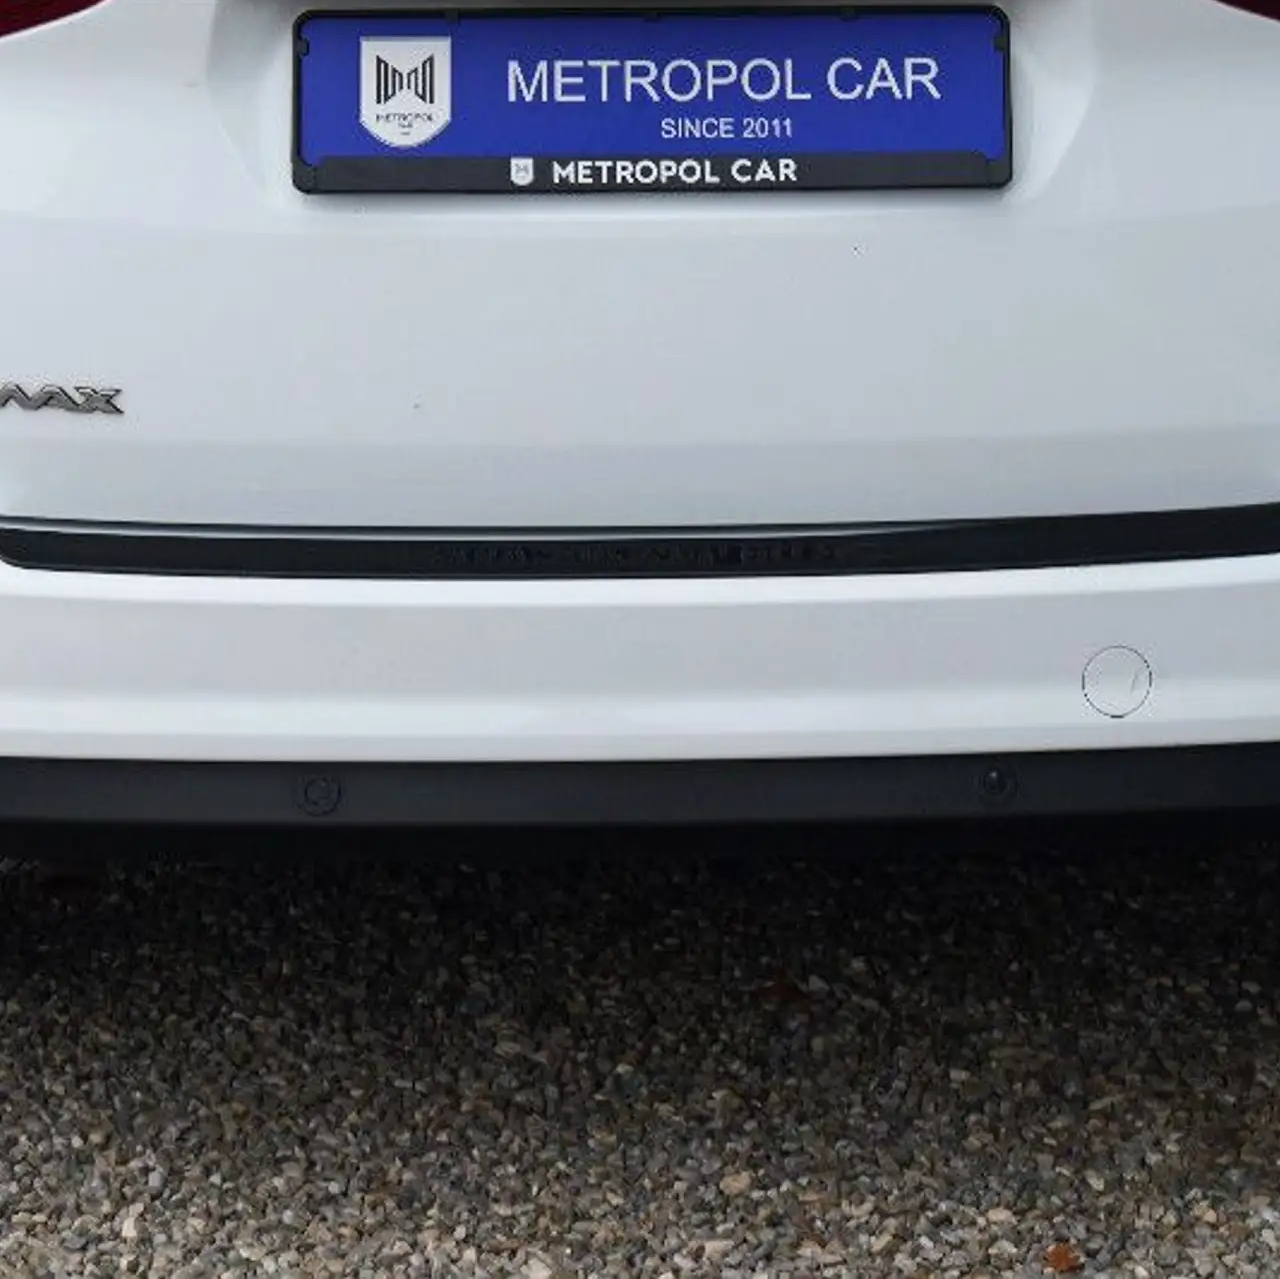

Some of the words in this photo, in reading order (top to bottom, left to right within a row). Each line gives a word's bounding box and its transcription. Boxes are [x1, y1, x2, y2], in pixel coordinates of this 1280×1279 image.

[507, 58, 812, 103] METROPOL
[827, 56, 942, 102] CAR
[660, 117, 734, 139] SINCE
[742, 116, 793, 139] 2011
[552, 159, 720, 186] METROPOL
[731, 158, 798, 184] CAR
